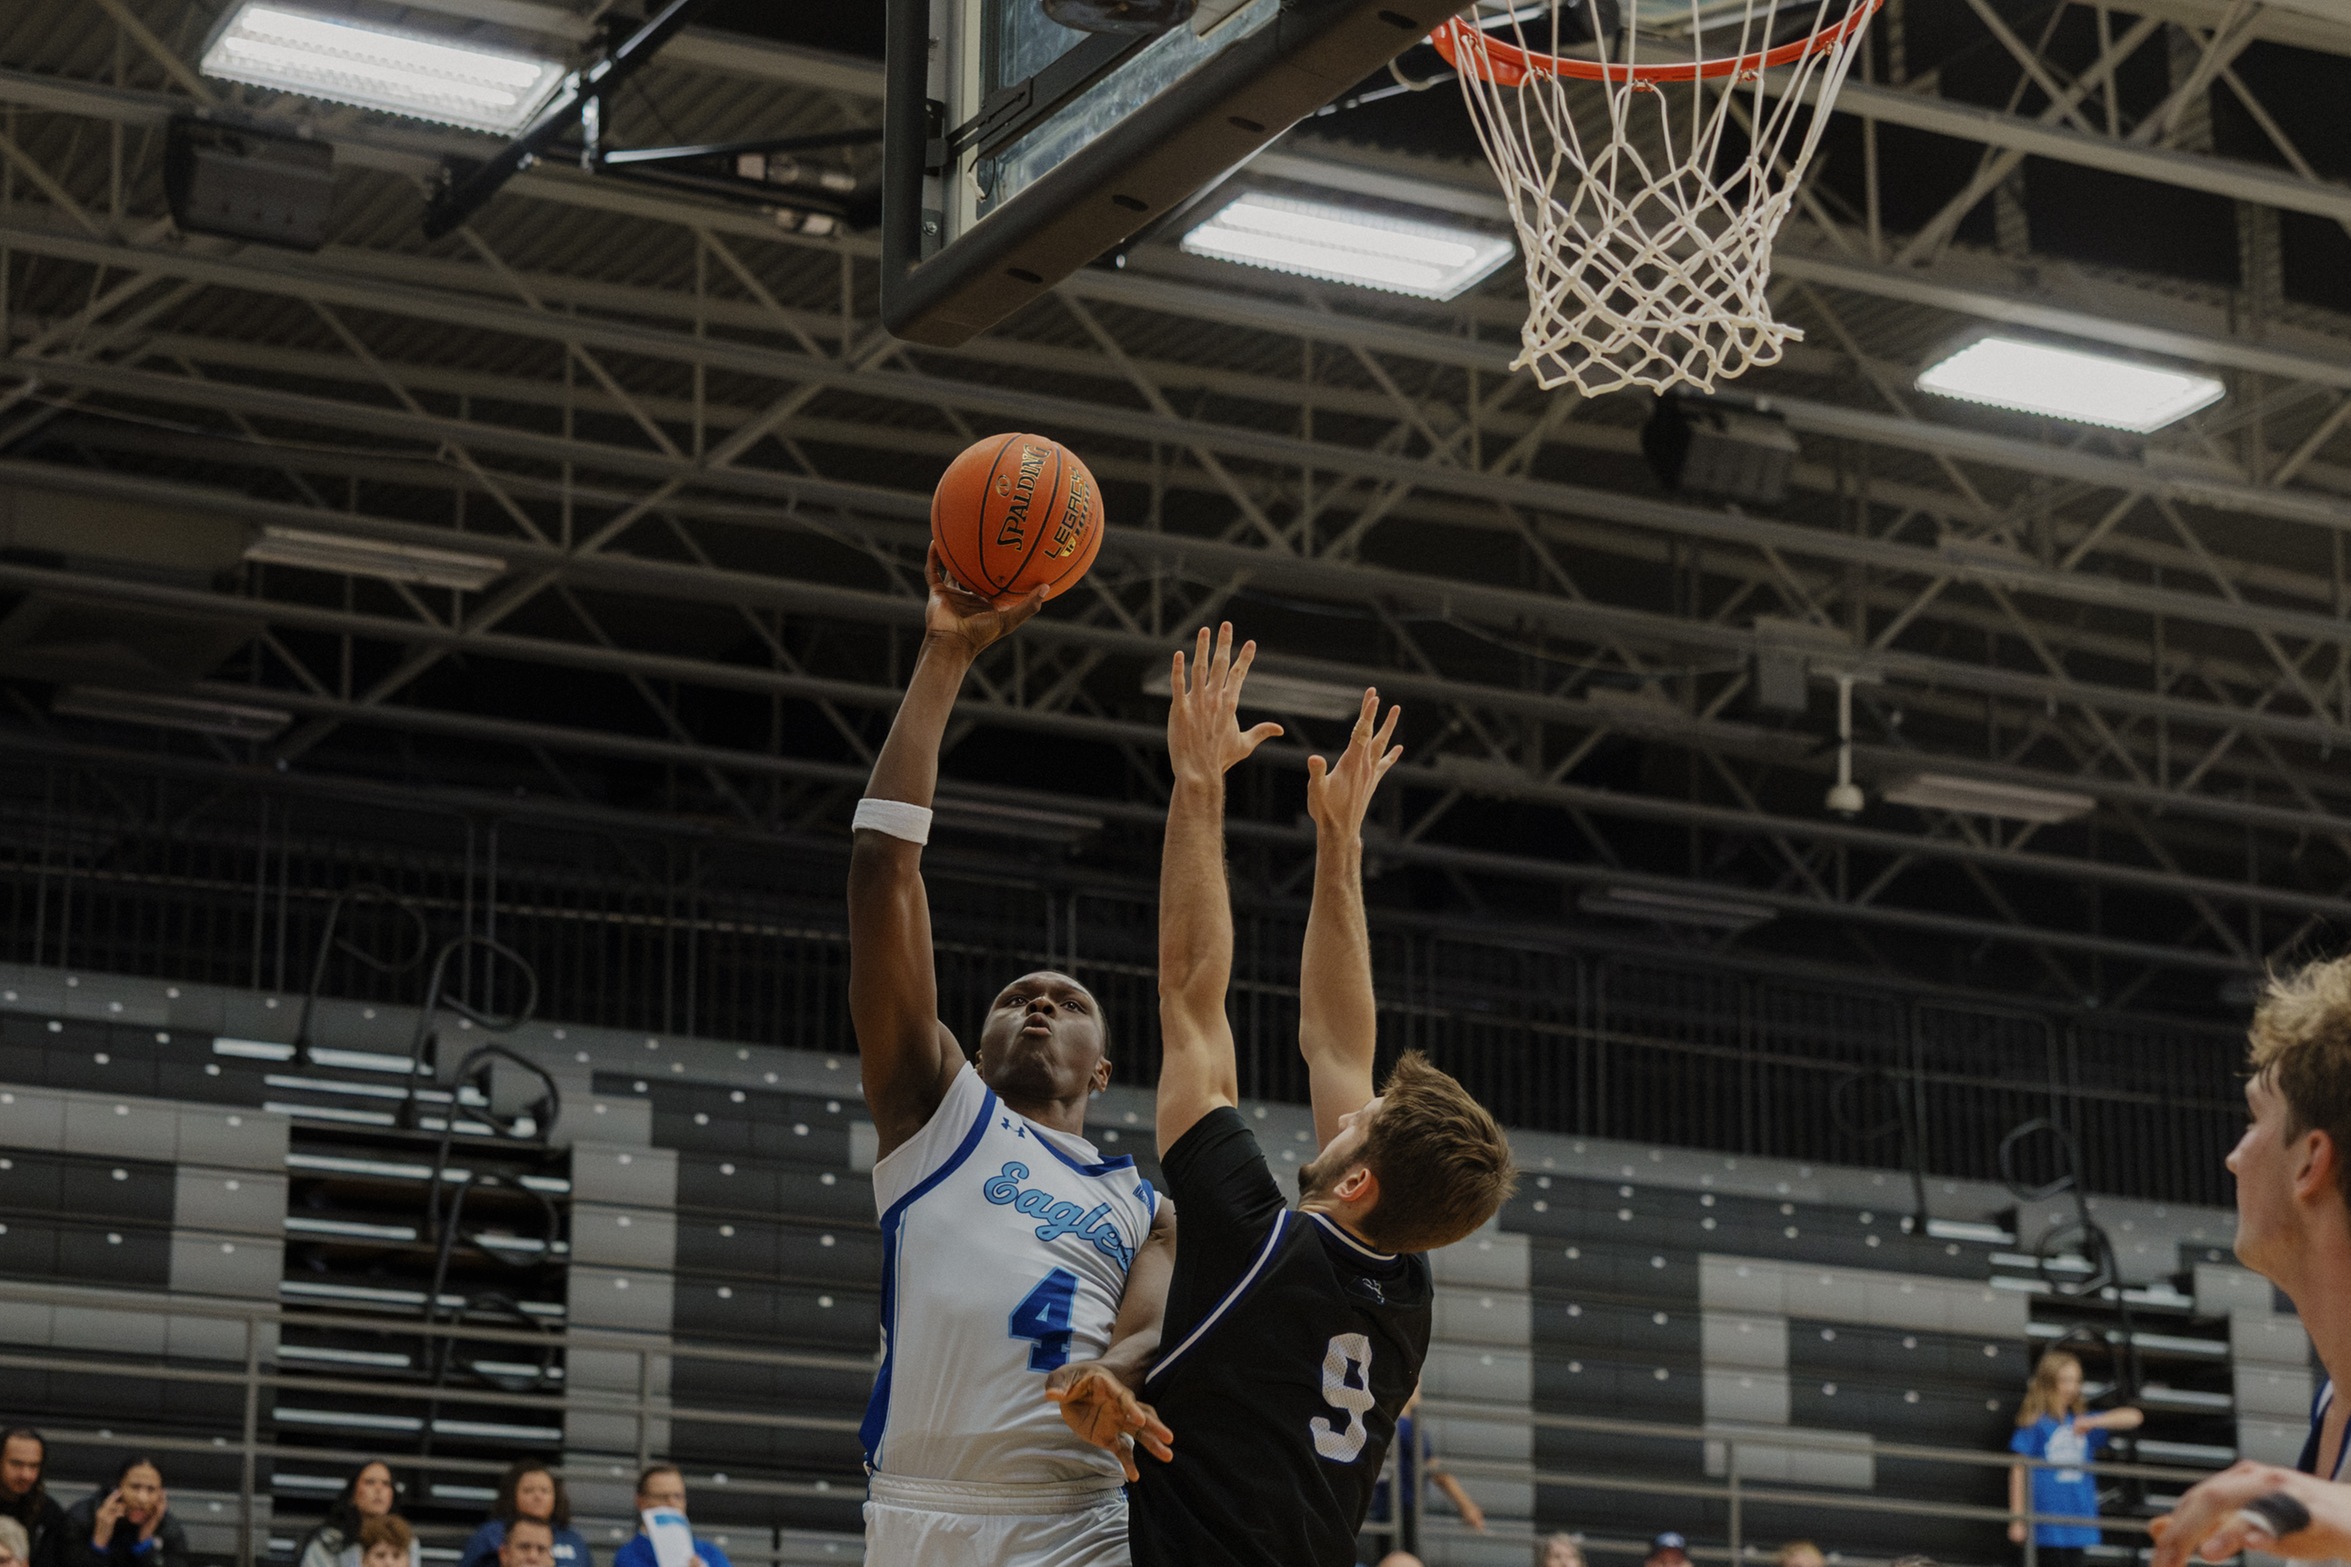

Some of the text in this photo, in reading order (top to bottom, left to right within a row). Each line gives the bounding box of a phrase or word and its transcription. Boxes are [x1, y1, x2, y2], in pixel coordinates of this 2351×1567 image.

[997, 444, 1051, 551] SPALDING
[1043, 466, 1083, 560] LEGACY
[1008, 1266, 1080, 1374] 4
[1309, 1332, 1376, 1463] 9
